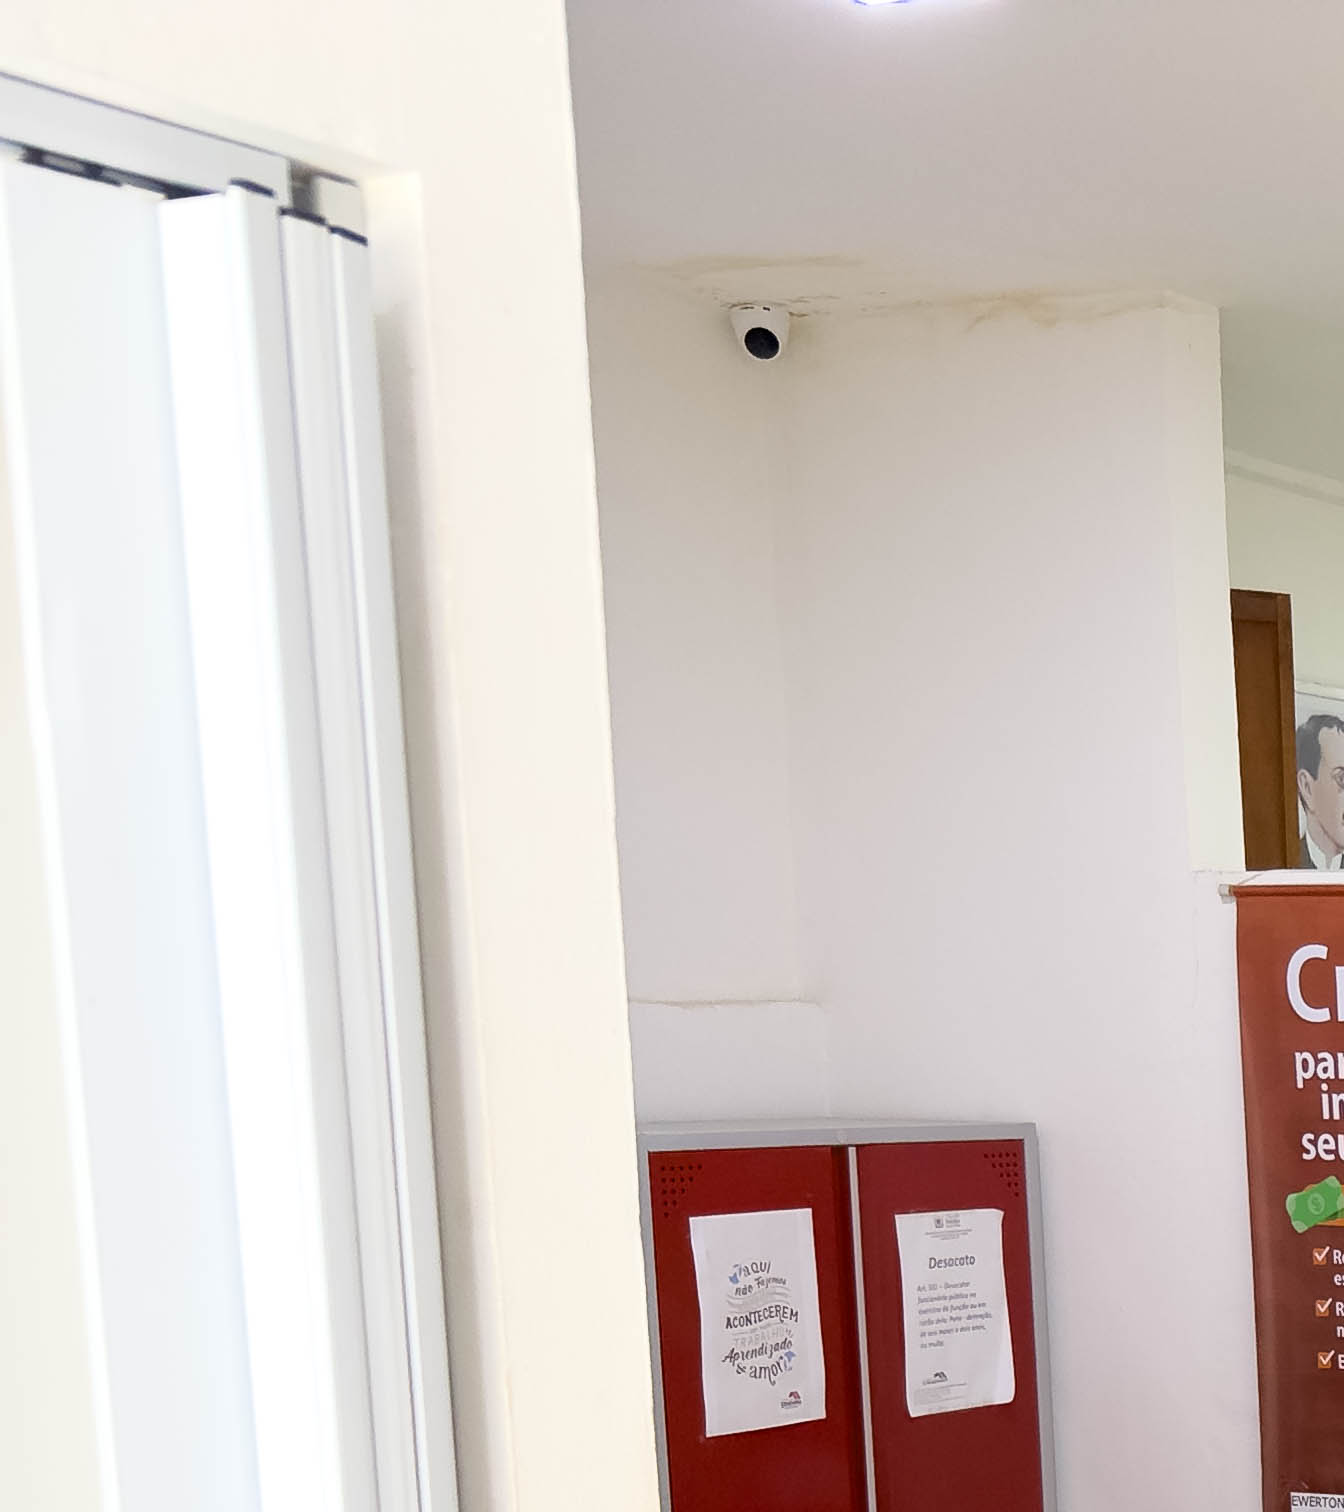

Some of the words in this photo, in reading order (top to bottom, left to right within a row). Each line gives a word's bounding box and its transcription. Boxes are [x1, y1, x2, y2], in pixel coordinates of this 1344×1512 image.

[928, 1254, 976, 1270] Desacato
[726, 1304, 799, 1329] ACONTECEREM
[722, 1337, 793, 1367] Aprendizado
[1291, 1495, 1344, 1509] EWERTON
